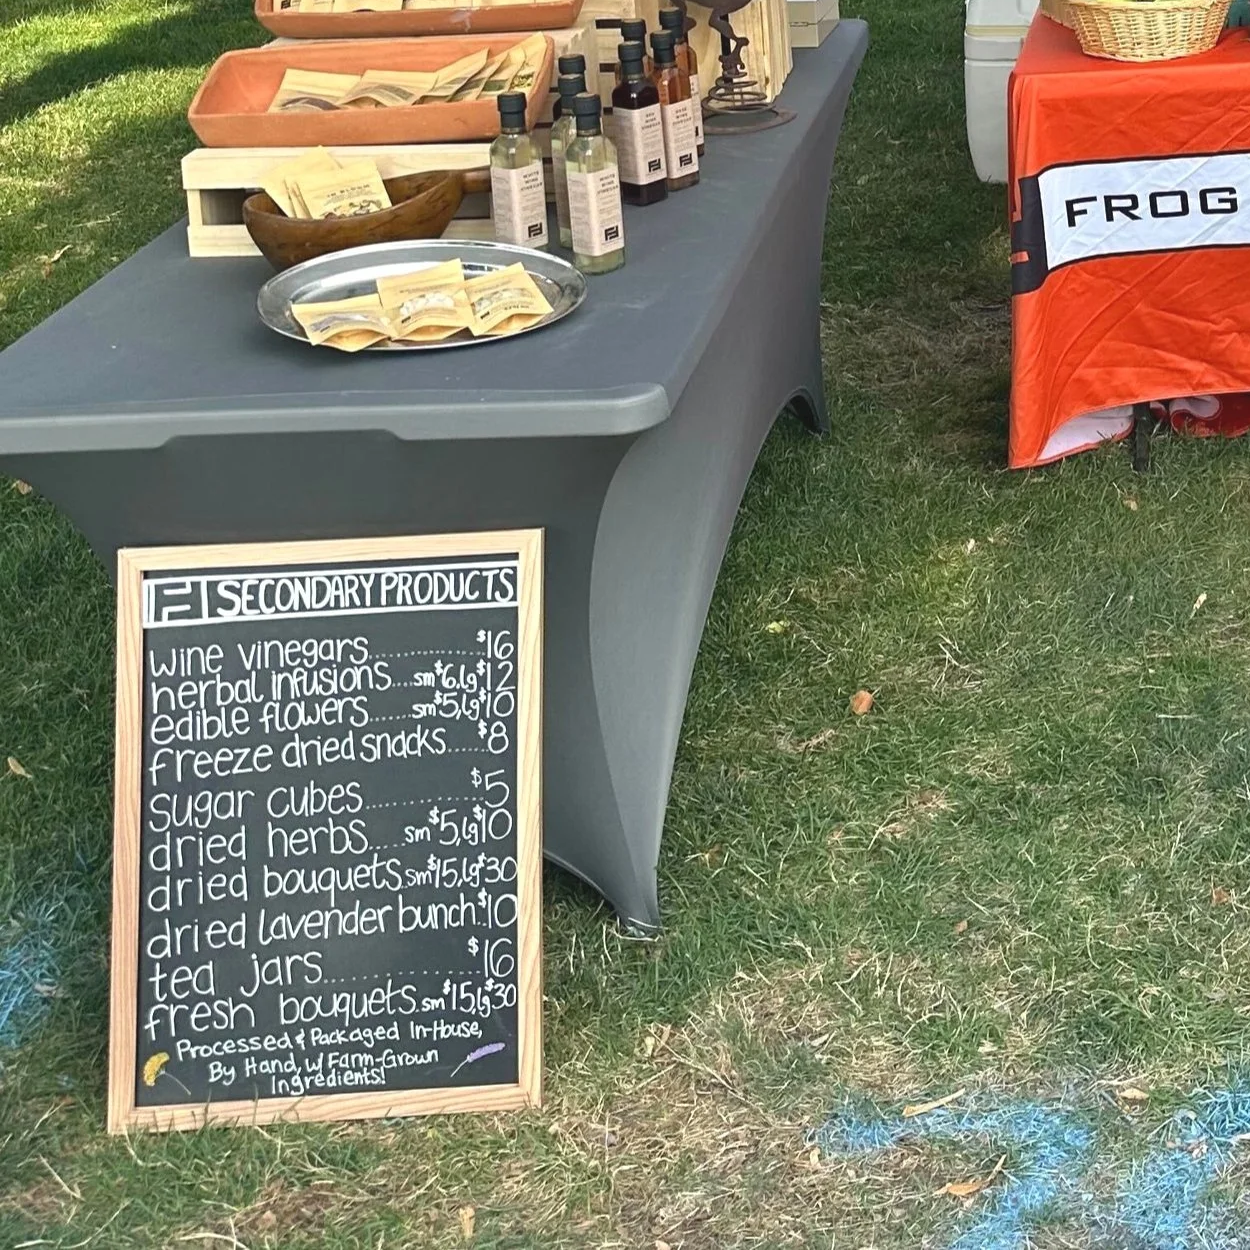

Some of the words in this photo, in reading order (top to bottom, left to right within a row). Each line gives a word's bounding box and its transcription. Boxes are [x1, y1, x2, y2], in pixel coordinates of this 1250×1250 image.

[1065, 185, 1239, 228] FROG
[216, 572, 376, 617] SECONDARY
[381, 568, 515, 606] PRODUCTS
[149, 643, 224, 678] wine
[237, 636, 369, 674] vinegars
[476, 629, 515, 660] $16
[151, 673, 264, 714] herbal
[271, 661, 392, 701] infusions
[150, 708, 250, 745] edible
[259, 696, 370, 734] flowers
[149, 745, 273, 786] freeze
[281, 732, 356, 769] dried
[360, 727, 448, 763] snacks
[478, 721, 510, 755] $8
[149, 789, 256, 833] sugar
[267, 780, 364, 819] cubes
[471, 768, 511, 808] $5
[148, 825, 248, 872] dried
[267, 818, 370, 859] herbs
[147, 865, 249, 912] dried
[263, 853, 403, 908] bouquets
[147, 912, 248, 960] dried
[258, 900, 394, 946] lavender
[398, 892, 478, 933] bunch
[477, 888, 518, 930] $10
[148, 962, 217, 1003] tea
[240, 951, 323, 996] jars
[467, 935, 515, 979] $16
[145, 1000, 256, 1042] fresh
[279, 980, 418, 1026] bouquets
[176, 1033, 294, 1061] Processed
[311, 1021, 400, 1049] Packaged
[208, 1061, 237, 1086] By
[327, 1049, 440, 1069] Farm-Grown
[271, 1066, 387, 1096] Ingredients!
